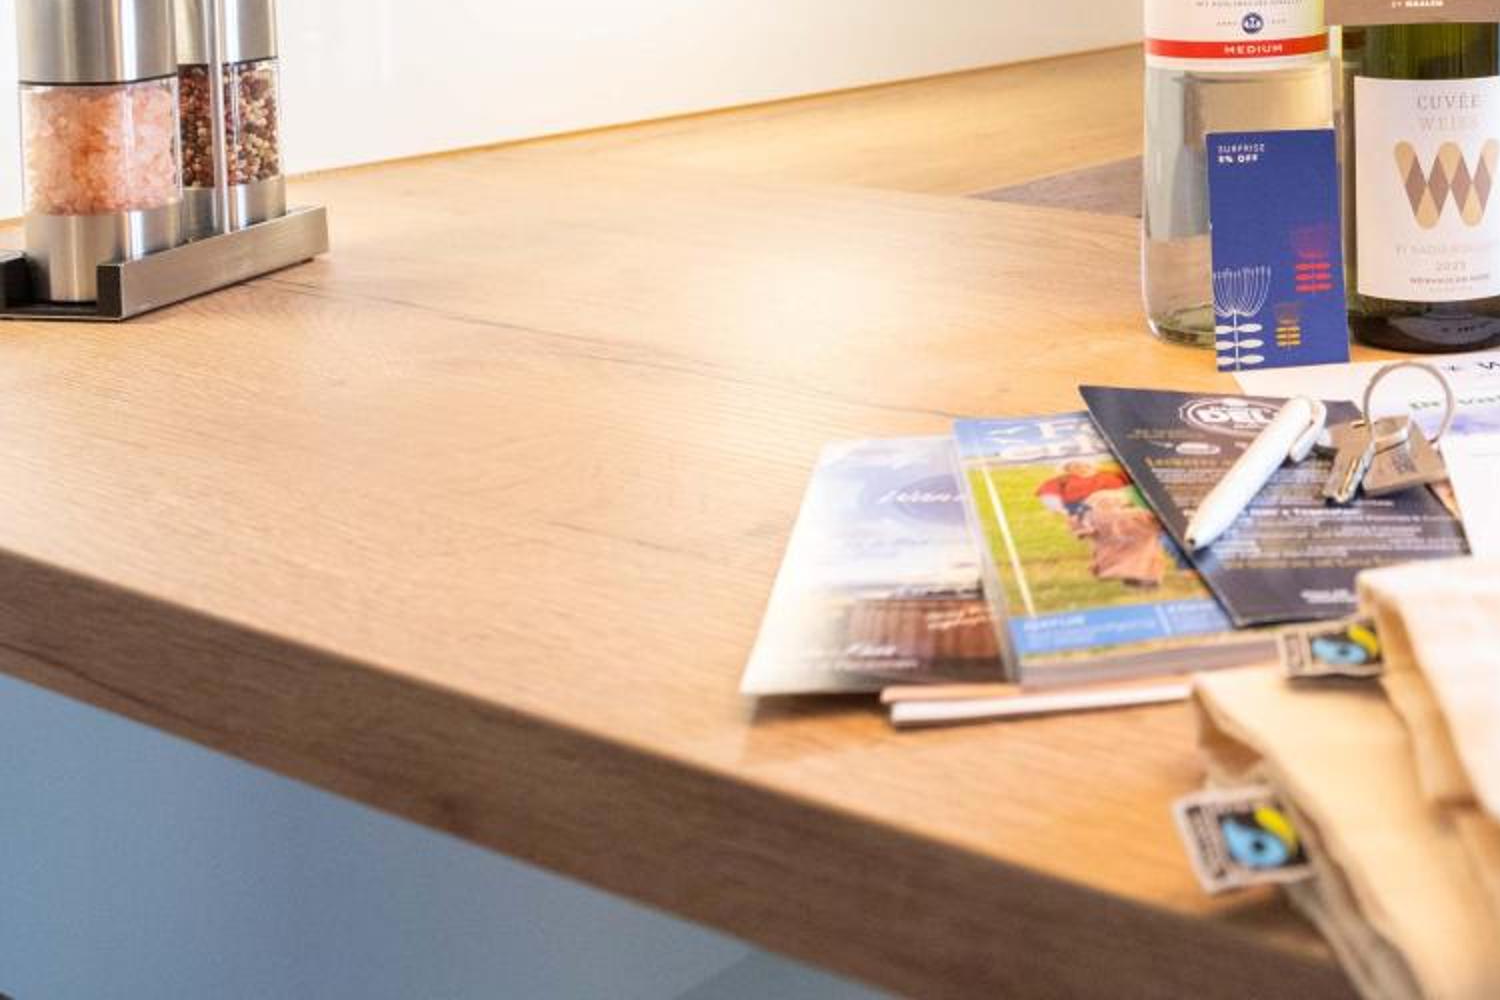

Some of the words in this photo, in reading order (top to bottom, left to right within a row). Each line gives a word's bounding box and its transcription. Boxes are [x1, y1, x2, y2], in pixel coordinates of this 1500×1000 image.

[1223, 43, 1284, 56] MEDIUM
[1217, 143, 1265, 153] SURPRISE
[1237, 153, 1258, 163] OFF
